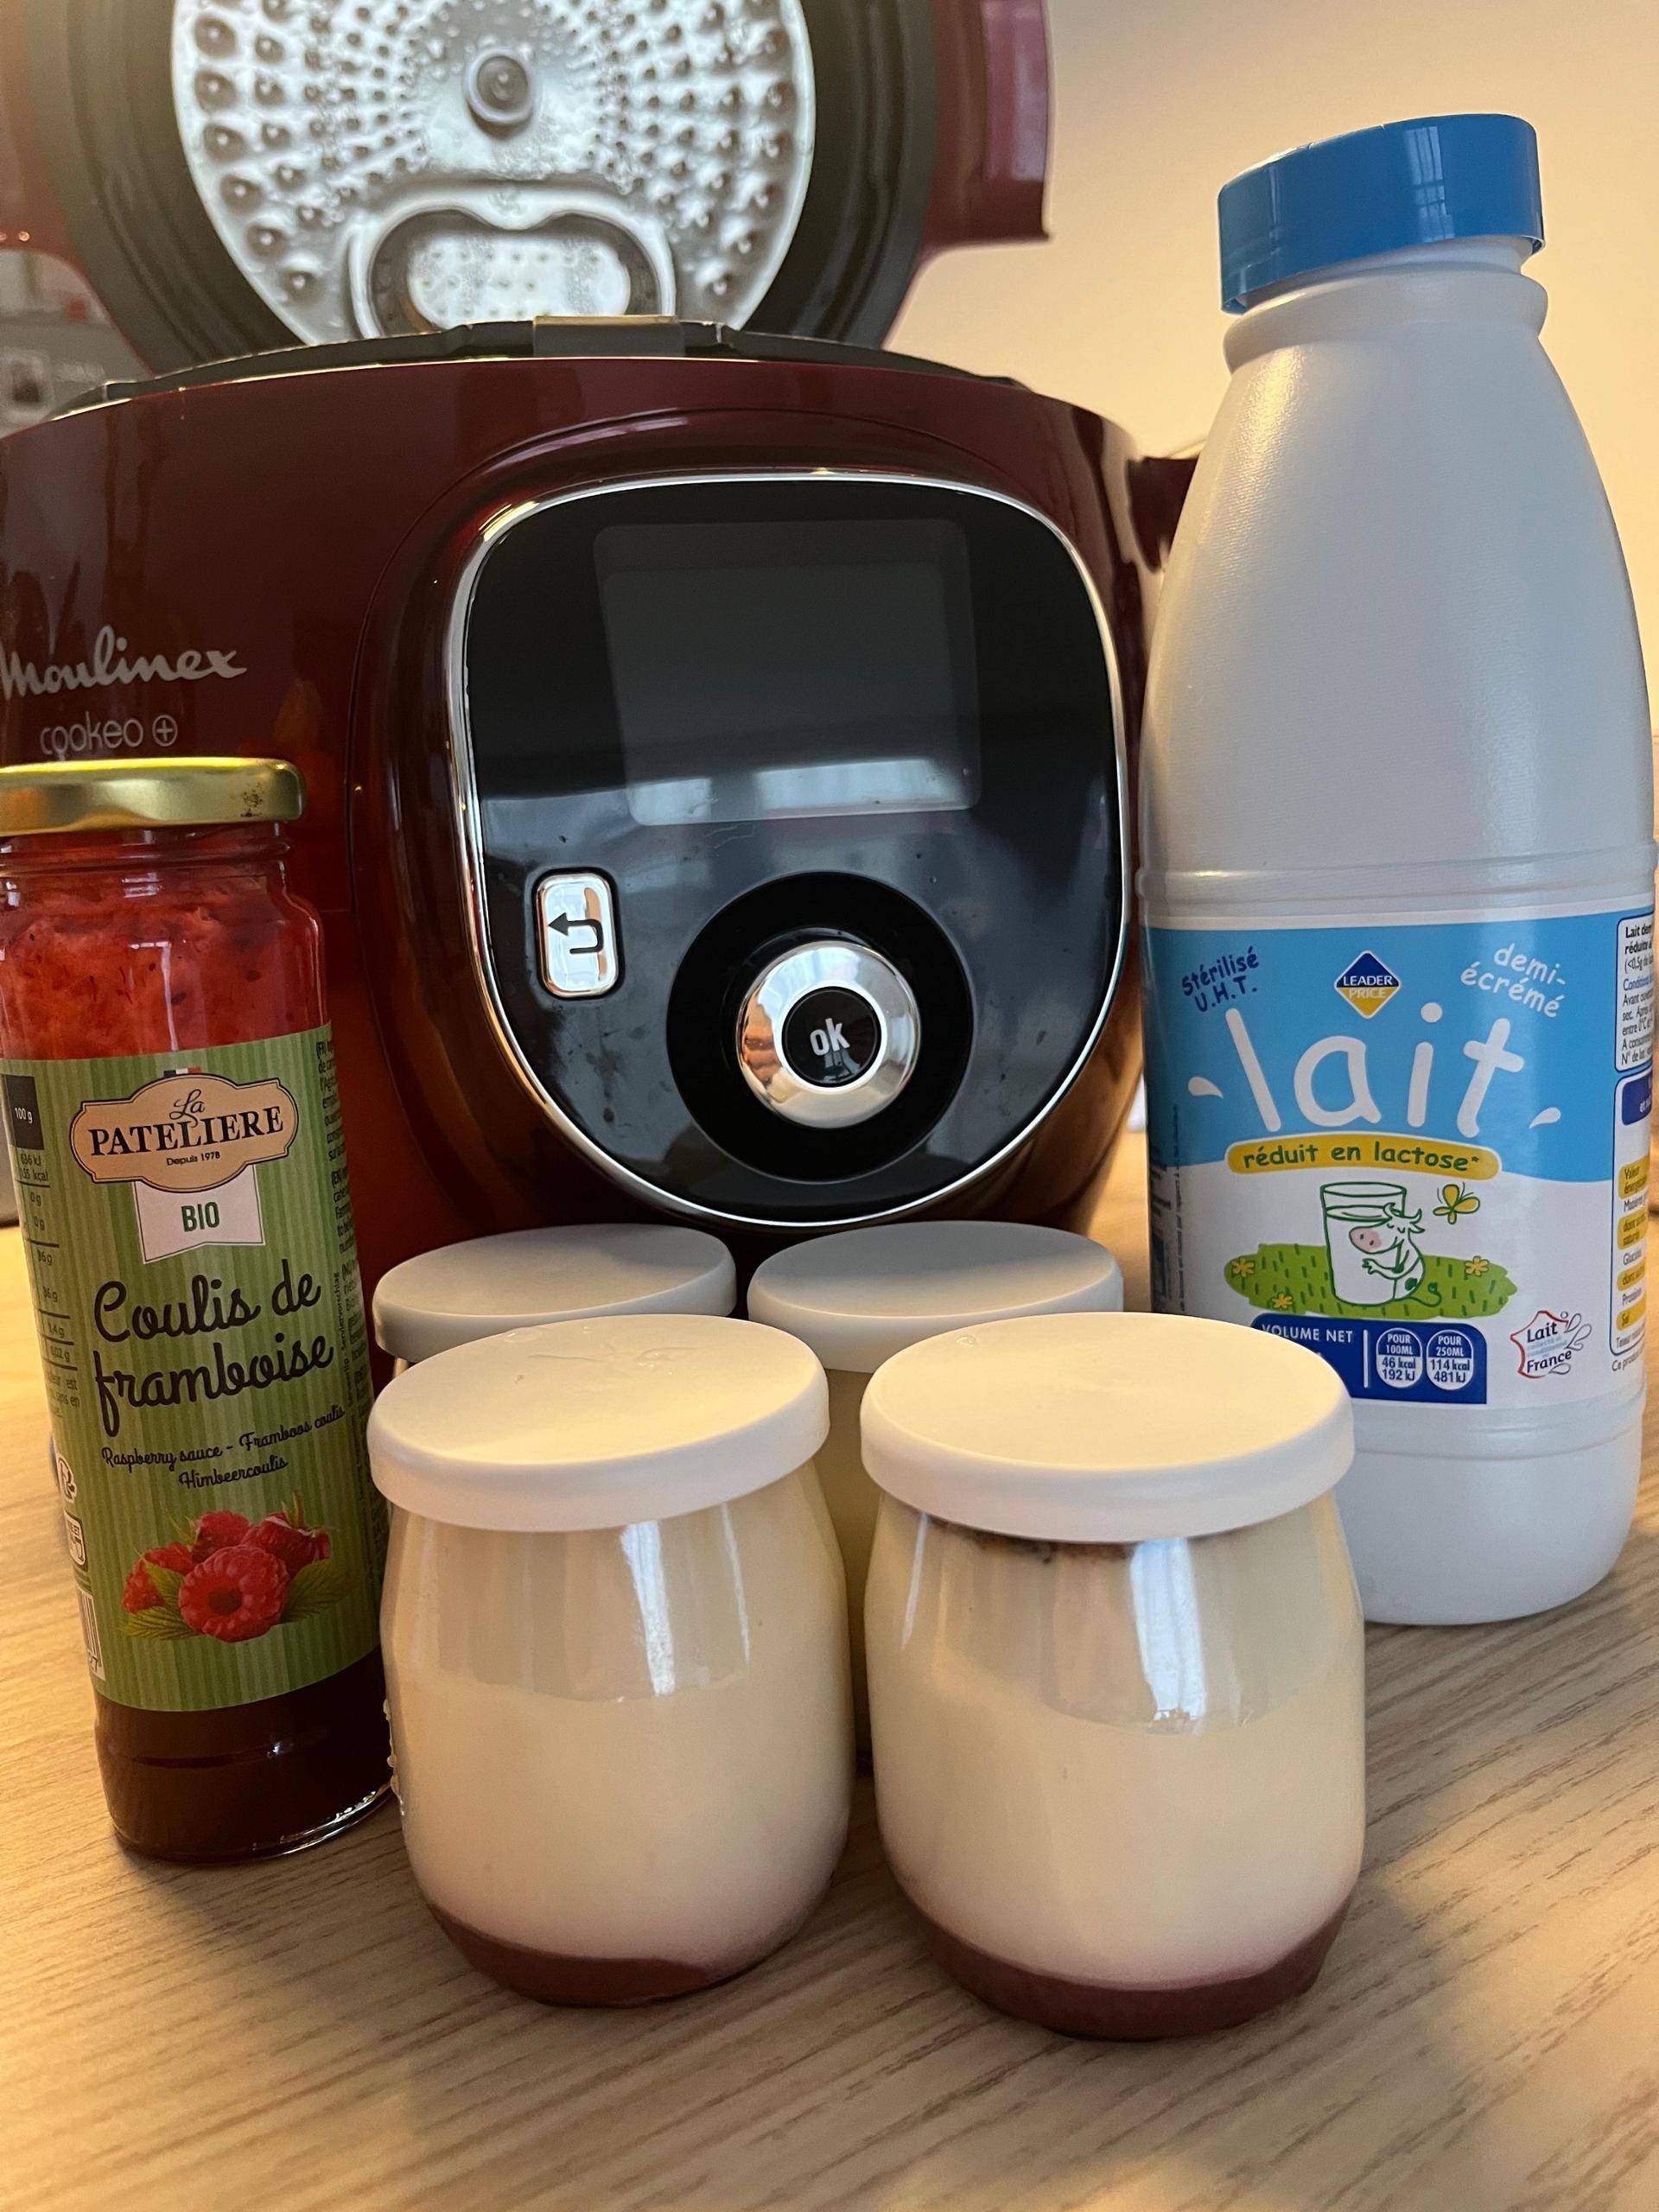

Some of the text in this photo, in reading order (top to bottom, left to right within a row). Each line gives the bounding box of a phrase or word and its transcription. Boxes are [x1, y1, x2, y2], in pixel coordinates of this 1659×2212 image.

[0, 626, 247, 701] Moulinex
[1181, 945, 1260, 996] Stérilisé
[1493, 942, 1566, 984] demi-
[1343, 975, 1393, 986] LEADER
[1460, 961, 1565, 1017] écrémé
[1194, 975, 1258, 1012] U.H.T.
[1349, 987, 1387, 999] PRICE
[810, 1018, 850, 1056] ok
[1224, 1002, 1526, 1138] lait
[15, 1107, 33, 1124] 100 g
[169, 1089, 206, 1128] La
[88, 1106, 283, 1156] PATELIERE
[167, 1151, 220, 1166] Depuis 1978
[1243, 1143, 1319, 1169] réduit
[1331, 1146, 1361, 1161] en
[181, 1202, 220, 1233] BIO
[94, 1259, 321, 1342] Coulis de
[1262, 1324, 1353, 1343] VOLUME NET
[1387, 1333, 1411, 1344] POUR
[1438, 1335, 1462, 1346] POUR
[1527, 1322, 1558, 1343] Lait
[1386, 1344, 1413, 1355] 100ML
[1436, 1346, 1464, 1357] 250ML
[1382, 1357, 1415, 1369] 46 kcal
[1431, 1358, 1470, 1370] 114 kcal
[1527, 1351, 1572, 1373] France
[92, 1332, 334, 1437] framboise
[1382, 1369, 1415, 1381] 192 kJ
[1434, 1371, 1466, 1382] 481 kJ
[102, 1447, 176, 1472] Raspberry
[179, 1446, 223, 1462] sauce
[238, 1423, 313, 1451] Framboos
[315, 1405, 346, 1428] coulis
[179, 1454, 289, 1489] Himbeercoulis
